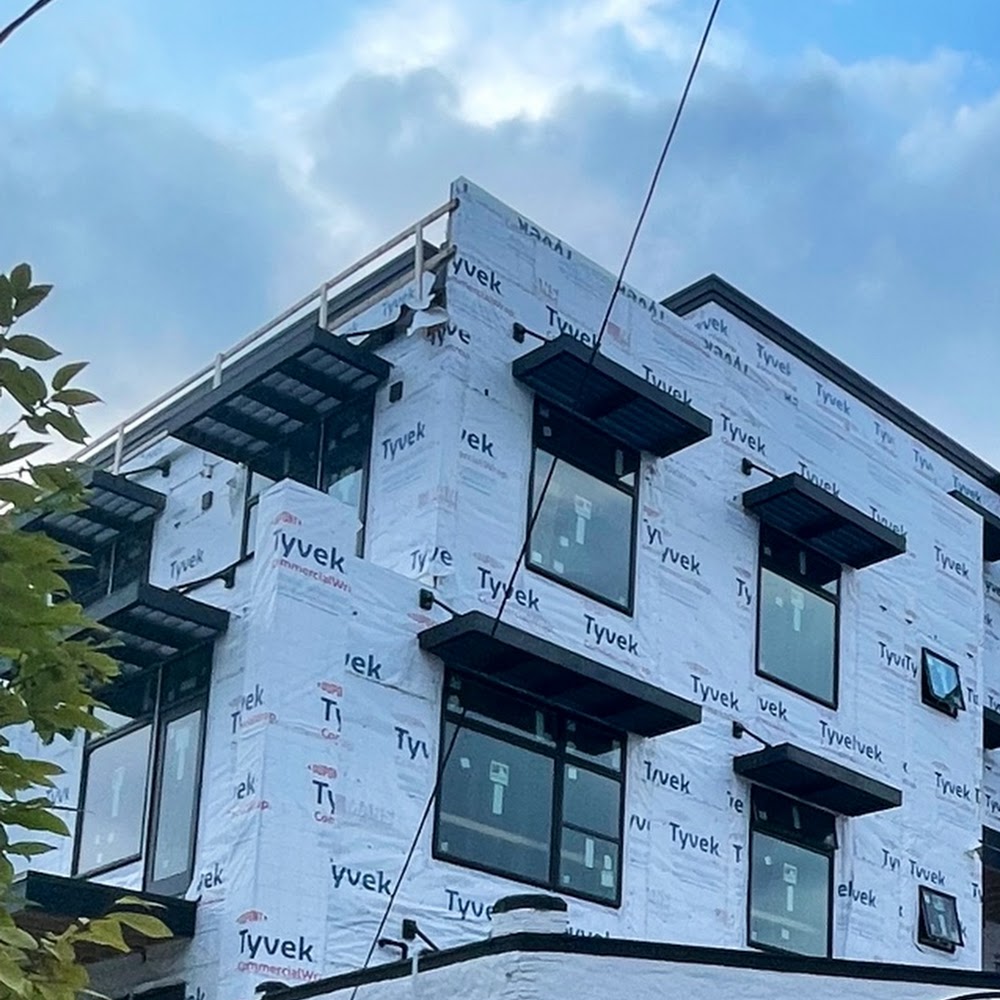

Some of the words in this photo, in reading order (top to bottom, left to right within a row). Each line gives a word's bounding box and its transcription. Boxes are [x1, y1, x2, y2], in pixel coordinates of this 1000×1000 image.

[382, 421, 426, 460] Tyvek
[720, 413, 767, 455] Tyvek
[273, 528, 346, 574] Tyvek
[934, 545, 969, 579] Tyvek
[477, 566, 540, 612] Tyvek
[584, 614, 639, 656] Tyvek
[690, 674, 740, 712] Tyvek
[934, 771, 971, 802] Tyvek
[669, 822, 721, 858] Tyvek
[329, 859, 393, 898] yvek
[238, 928, 313, 963] Tyvek
